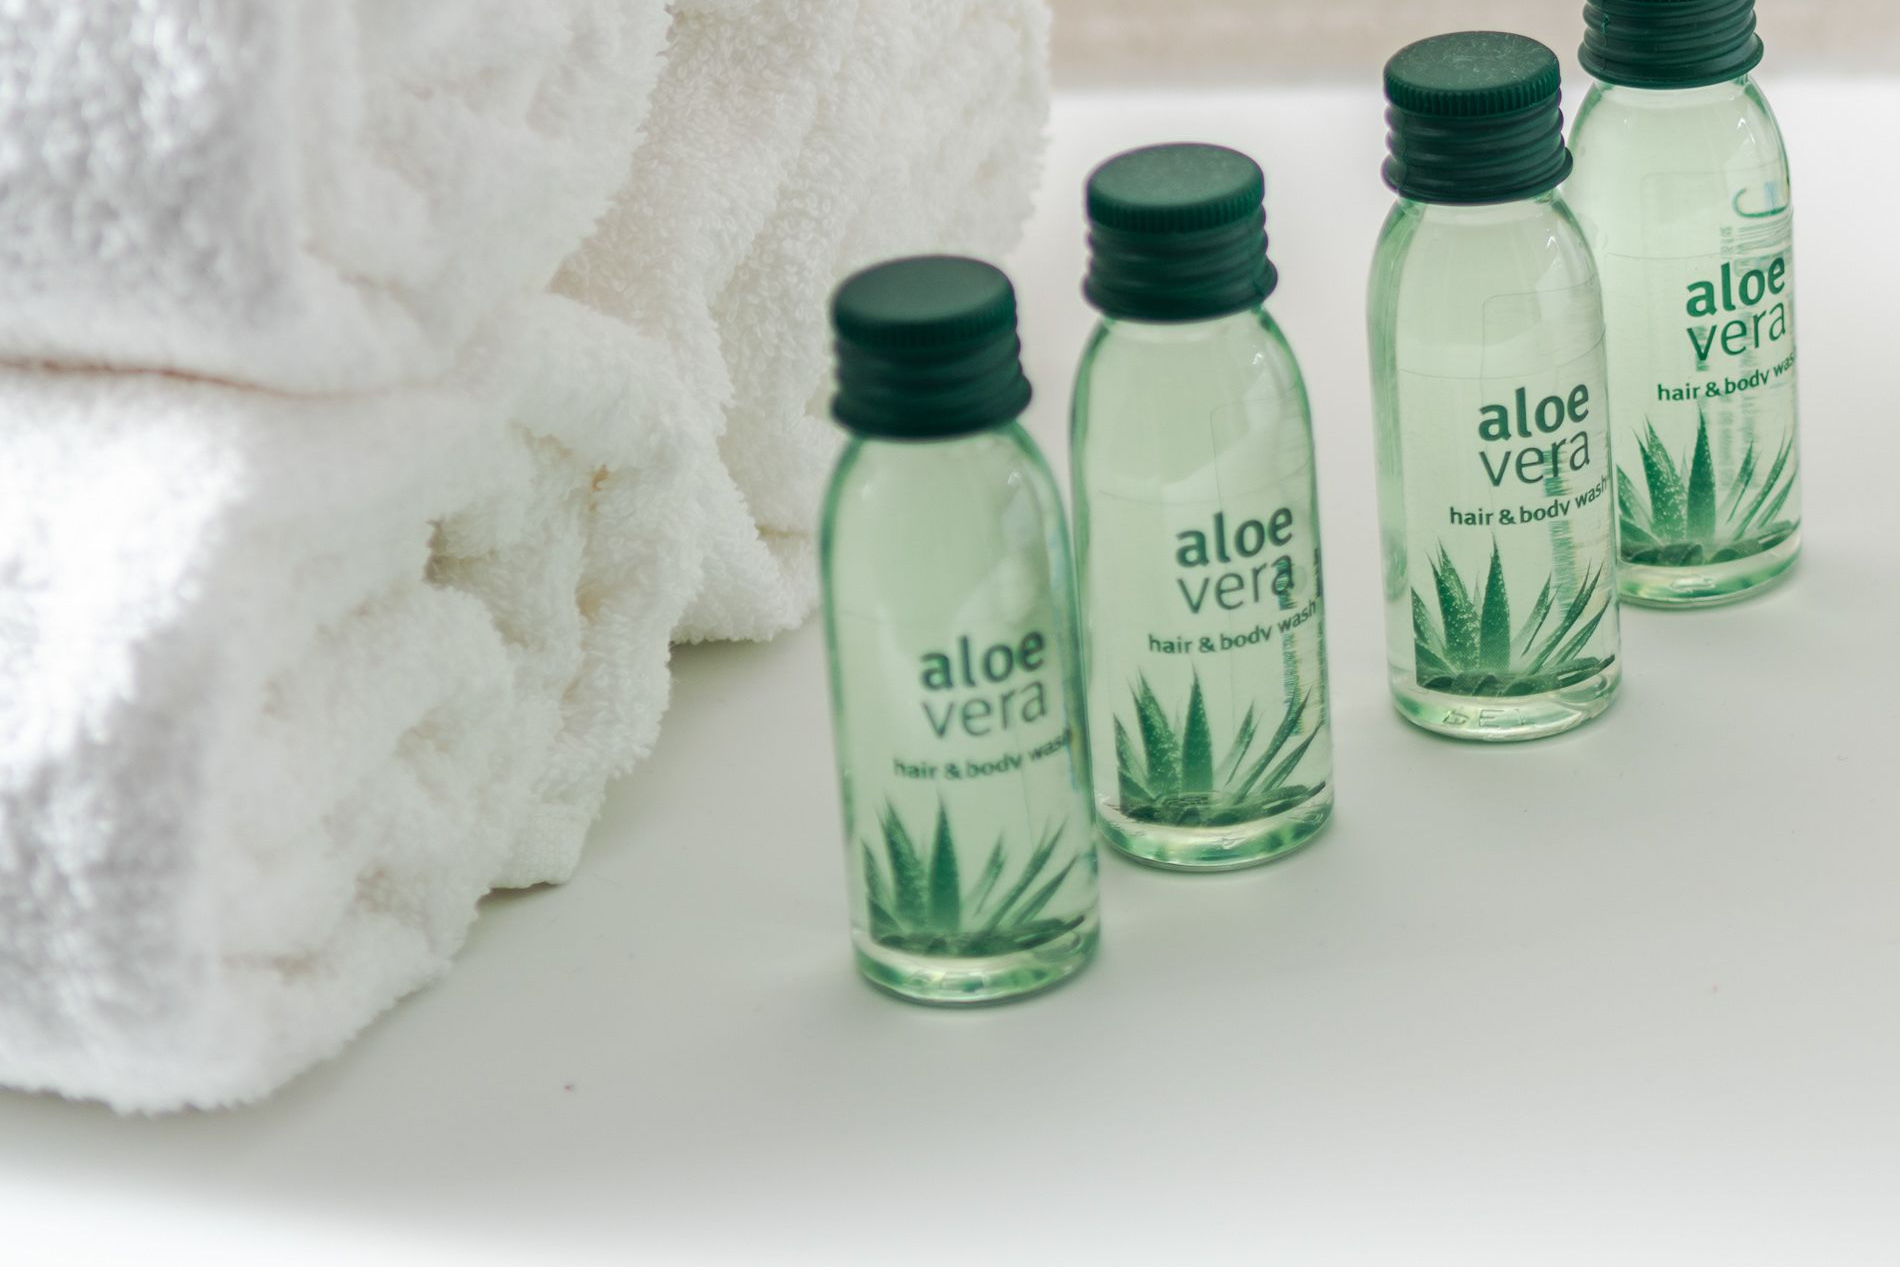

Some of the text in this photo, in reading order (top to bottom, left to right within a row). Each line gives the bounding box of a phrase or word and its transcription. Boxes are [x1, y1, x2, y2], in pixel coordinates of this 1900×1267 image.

[1686, 257, 1786, 317] aloe
[1686, 302, 1786, 362] vera
[1657, 351, 1797, 401] hair & body was
[1478, 384, 1589, 442] aloe
[1478, 431, 1591, 487] vera
[1450, 475, 1607, 526] hair & body wash
[1175, 507, 1293, 568] aloe
[1176, 555, 1295, 614] vera
[1149, 599, 1317, 654] hair & body wash
[919, 631, 1045, 691] aloe
[921, 680, 1047, 740] vera
[893, 758, 938, 779] hair
[944, 763, 961, 780] &
[966, 753, 1022, 778] body
